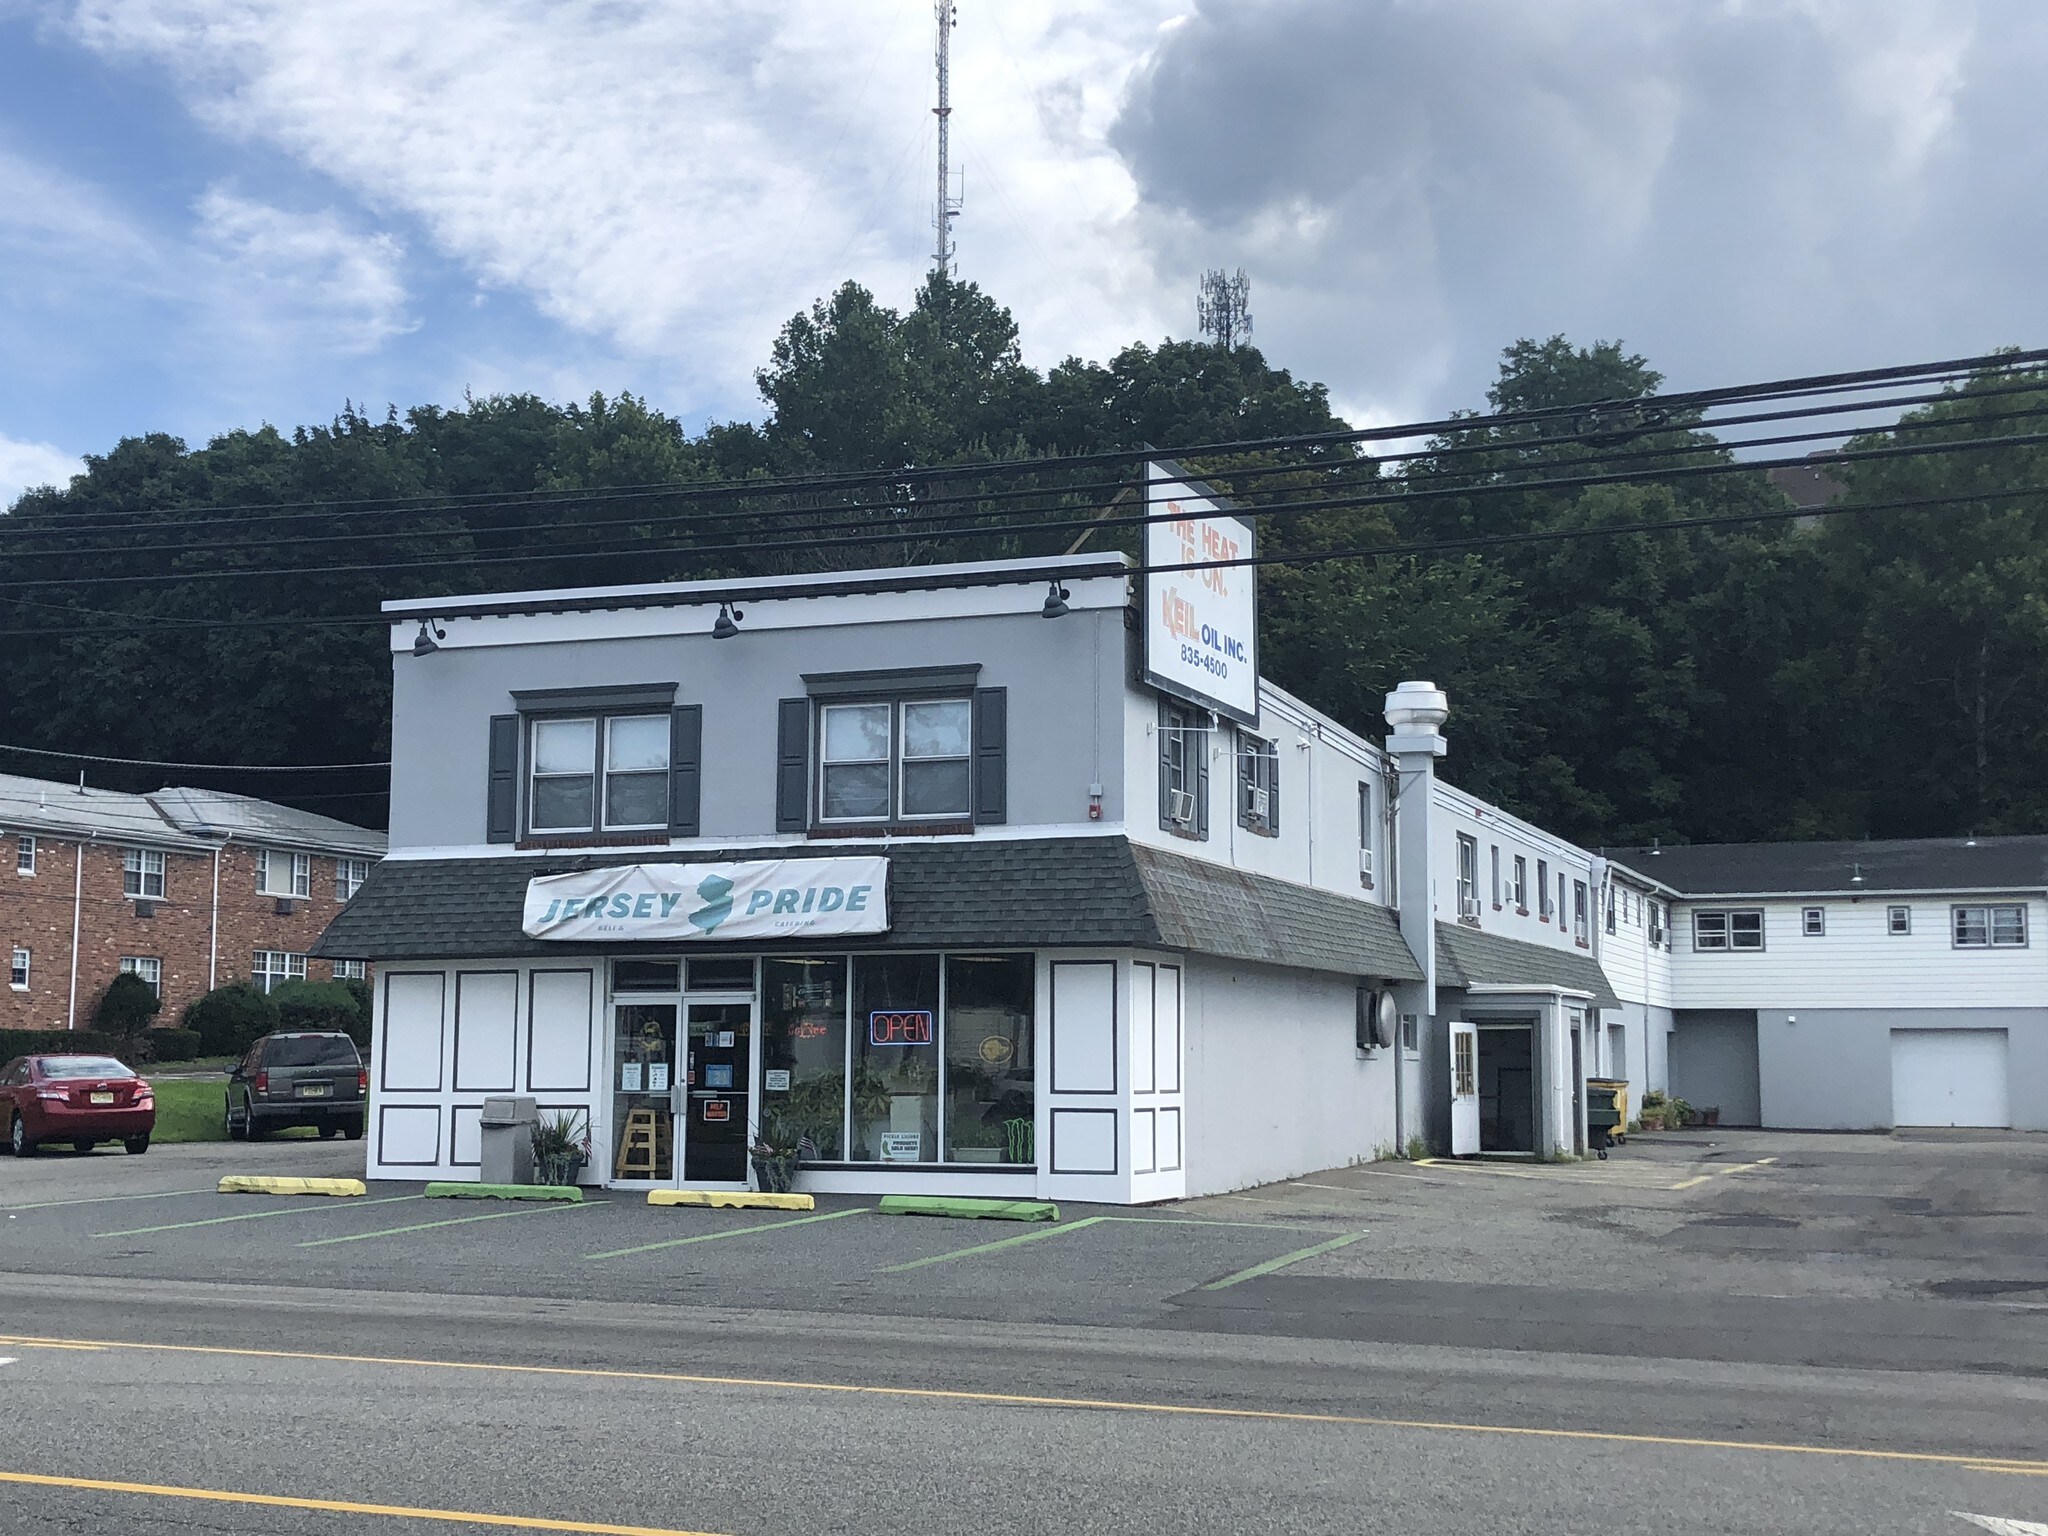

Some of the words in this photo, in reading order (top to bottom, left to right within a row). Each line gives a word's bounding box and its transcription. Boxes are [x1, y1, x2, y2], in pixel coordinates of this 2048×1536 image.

[1167, 501, 1195, 545] THE
[1201, 522, 1239, 570] HEAT
[1181, 543, 1195, 579] IS
[1162, 586, 1199, 641] KEIL
[1201, 623, 1221, 652] OIL
[1224, 634, 1248, 664] INC.
[537, 892, 682, 923] JERSEY
[746, 885, 872, 916] PRIDE
[873, 1014, 930, 1042] OPEN
